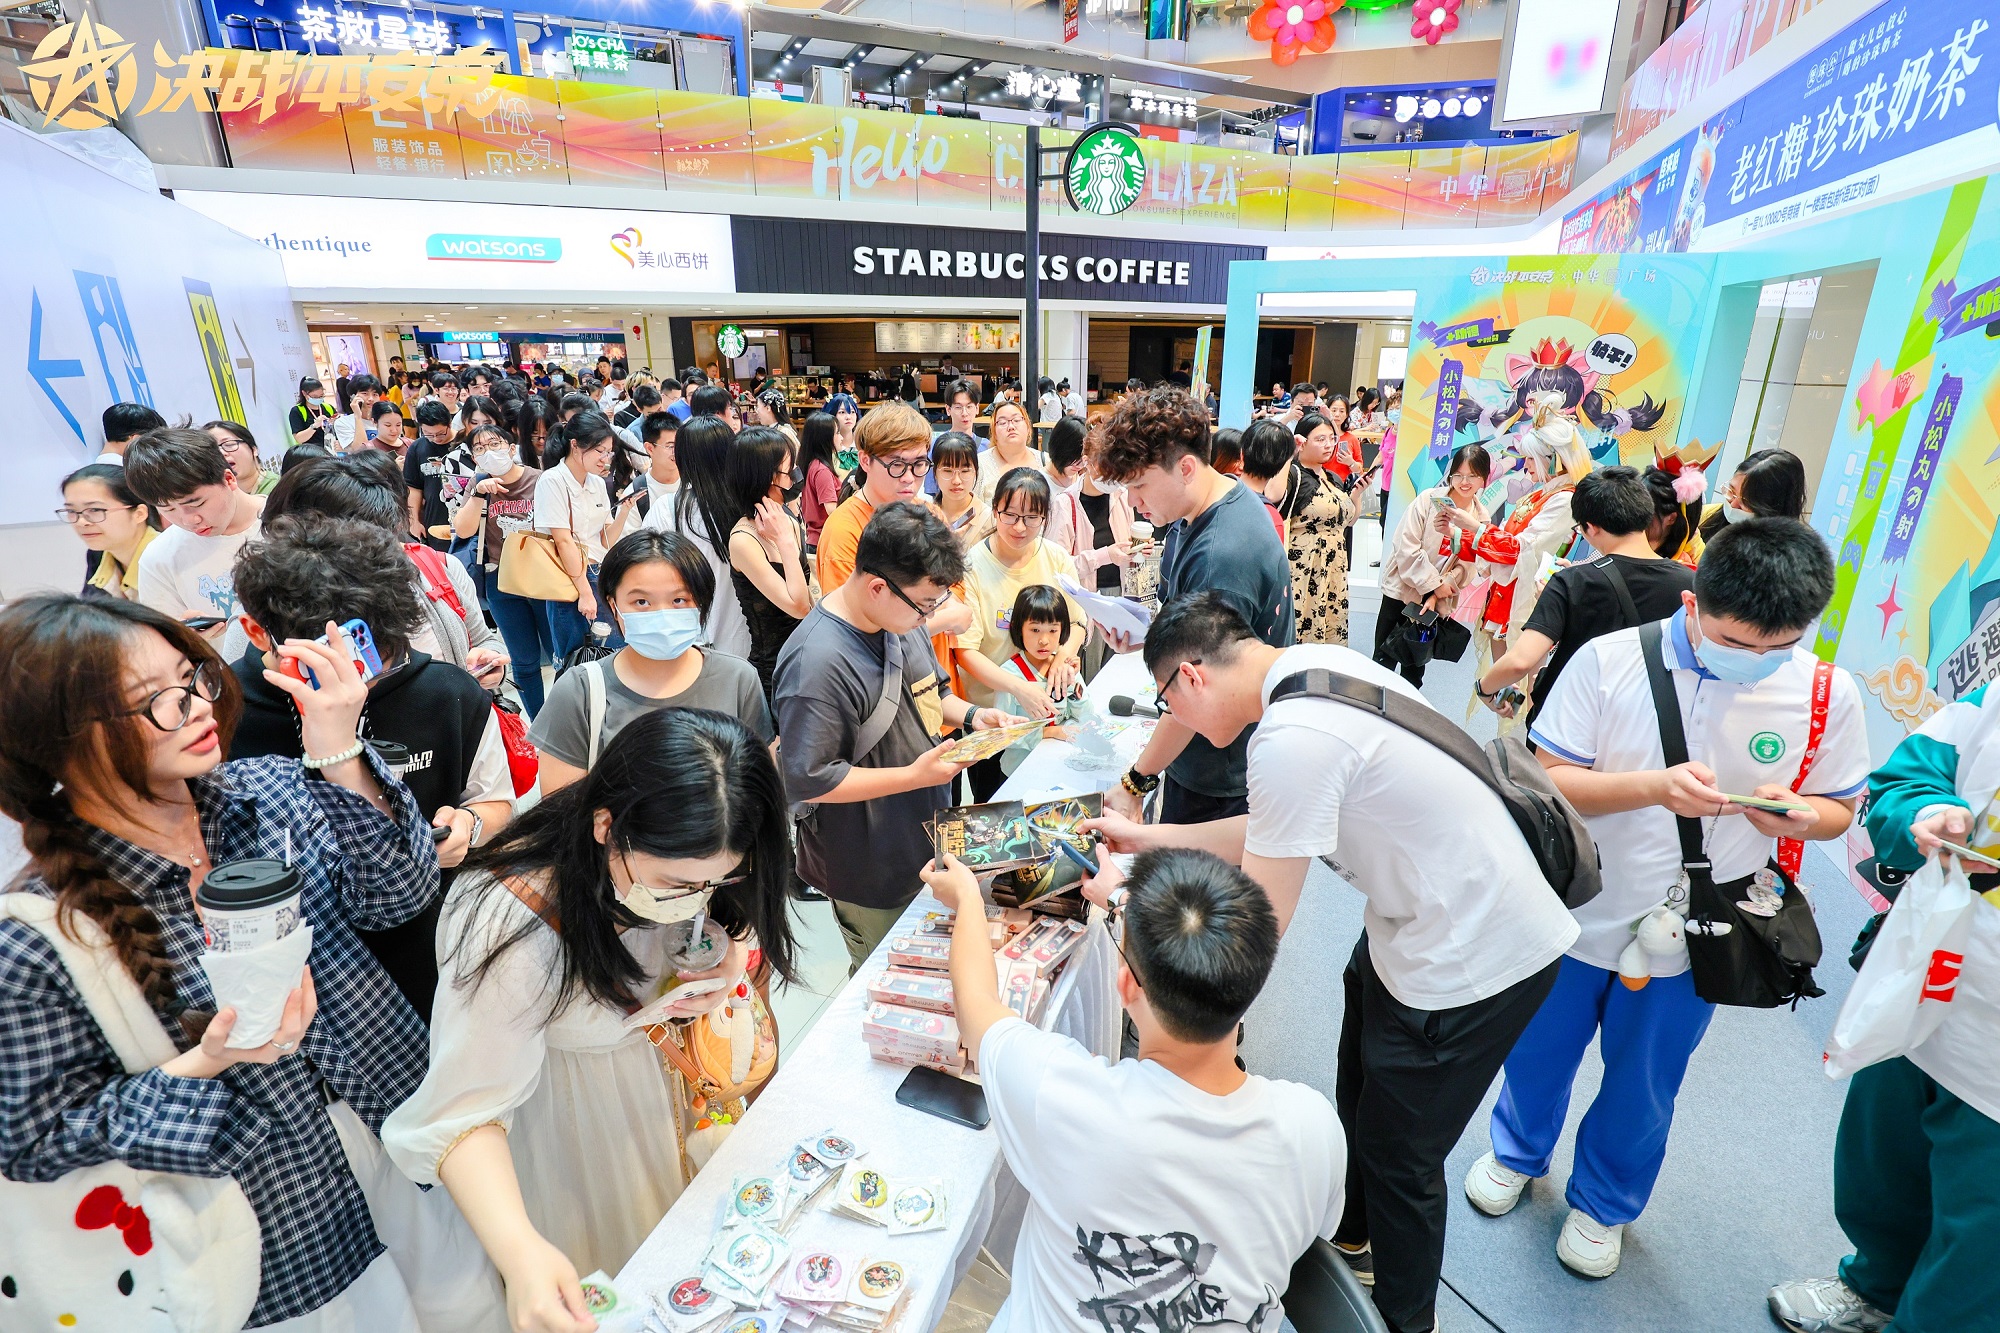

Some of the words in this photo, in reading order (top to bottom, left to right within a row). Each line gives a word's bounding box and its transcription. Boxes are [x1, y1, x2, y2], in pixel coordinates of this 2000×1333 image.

[296, 5, 452, 54] 茶救星球
[571, 34, 596, 48] JO's
[597, 37, 628, 52] CHA
[1726, 19, 1989, 205] 老红糖珍珠奶茶
[372, 137, 443, 157] 服装饰品
[812, 116, 949, 200] Hello
[1150, 158, 1238, 207] LAZA
[257, 232, 373, 258] thentique
[442, 236, 546, 258] watsons
[638, 248, 709, 270] 美心西饼
[1076, 256, 1190, 286] COFFEE
[452, 331, 493, 341] watsons
[1591, 340, 1633, 368] 躺平!
[1815, 675, 1828, 703] mixue
[405, 758, 432, 774] MILE
